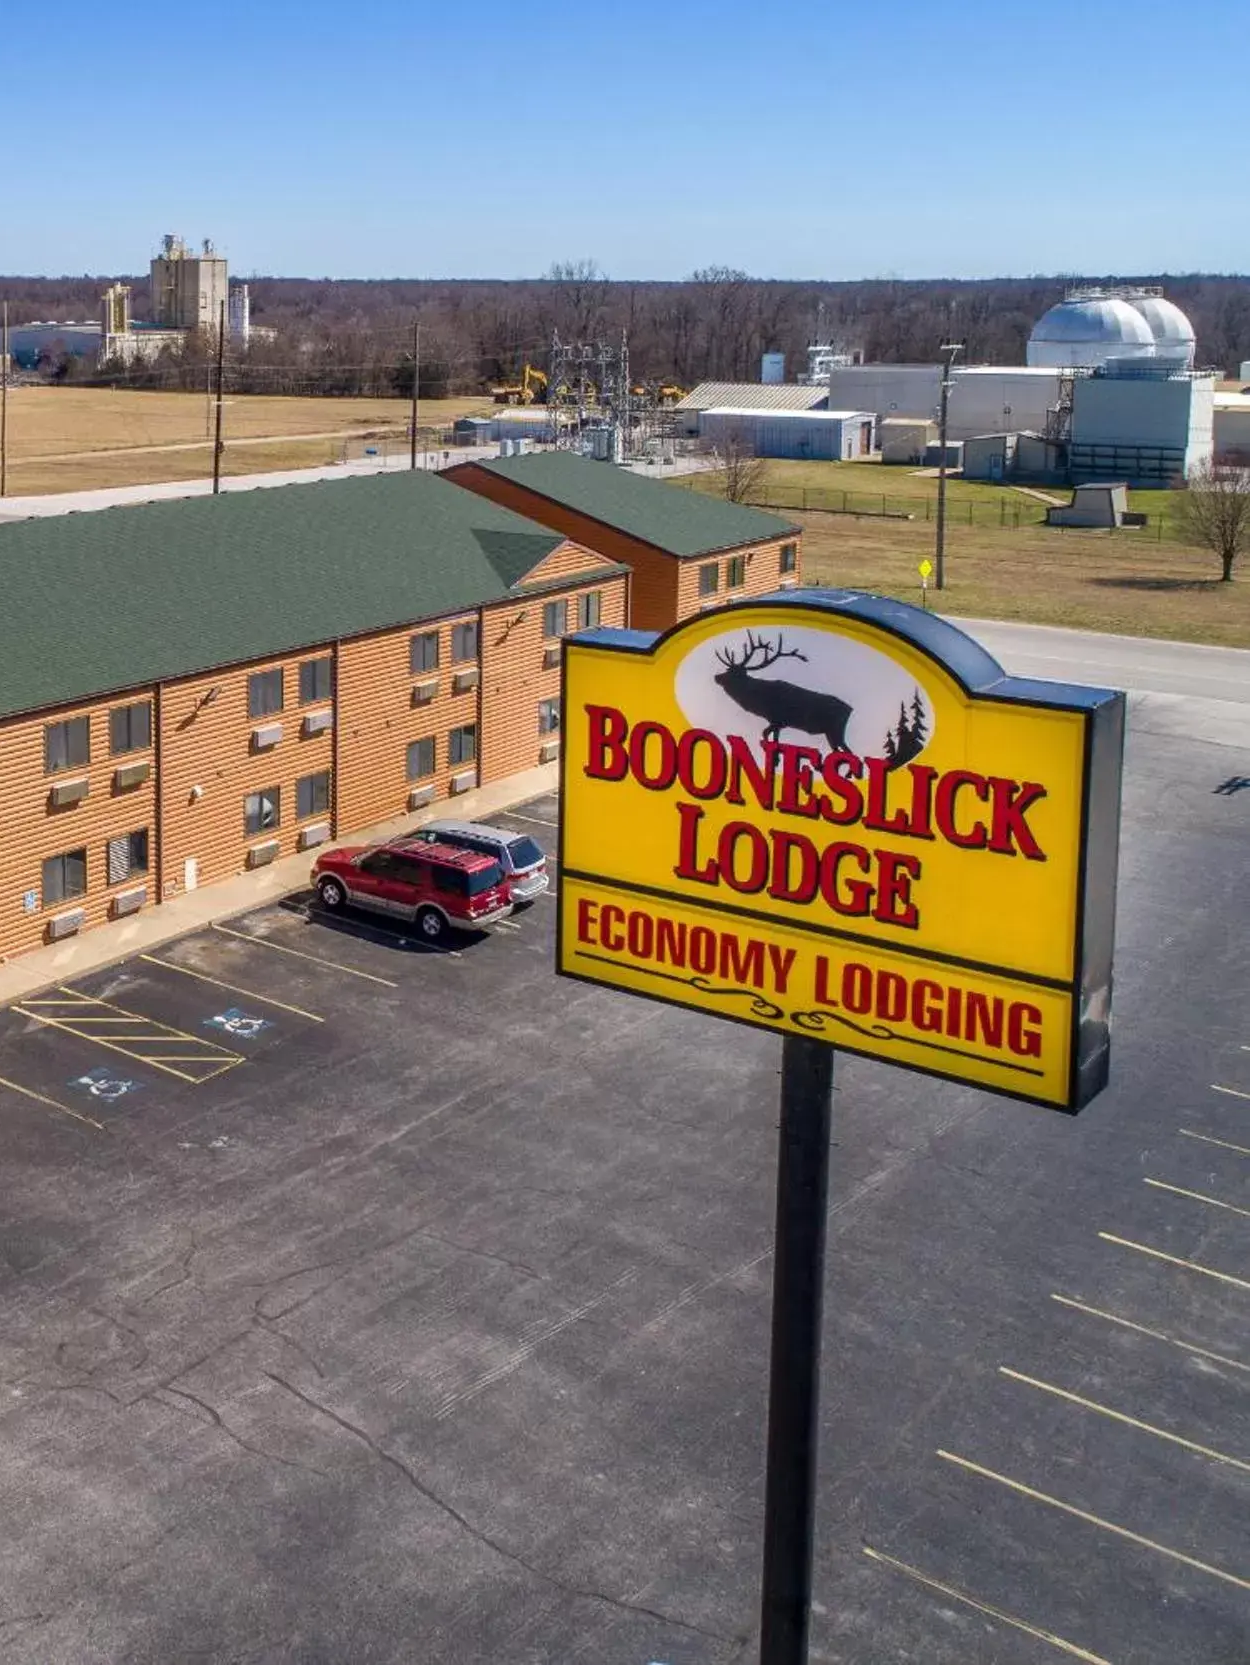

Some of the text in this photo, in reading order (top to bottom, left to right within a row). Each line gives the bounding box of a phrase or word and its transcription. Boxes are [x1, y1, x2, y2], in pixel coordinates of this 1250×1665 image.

[583, 704, 1047, 861] BOONESLICK
[674, 802, 921, 930] LODGE
[577, 898, 1043, 1058] ECONOMY LODGING
